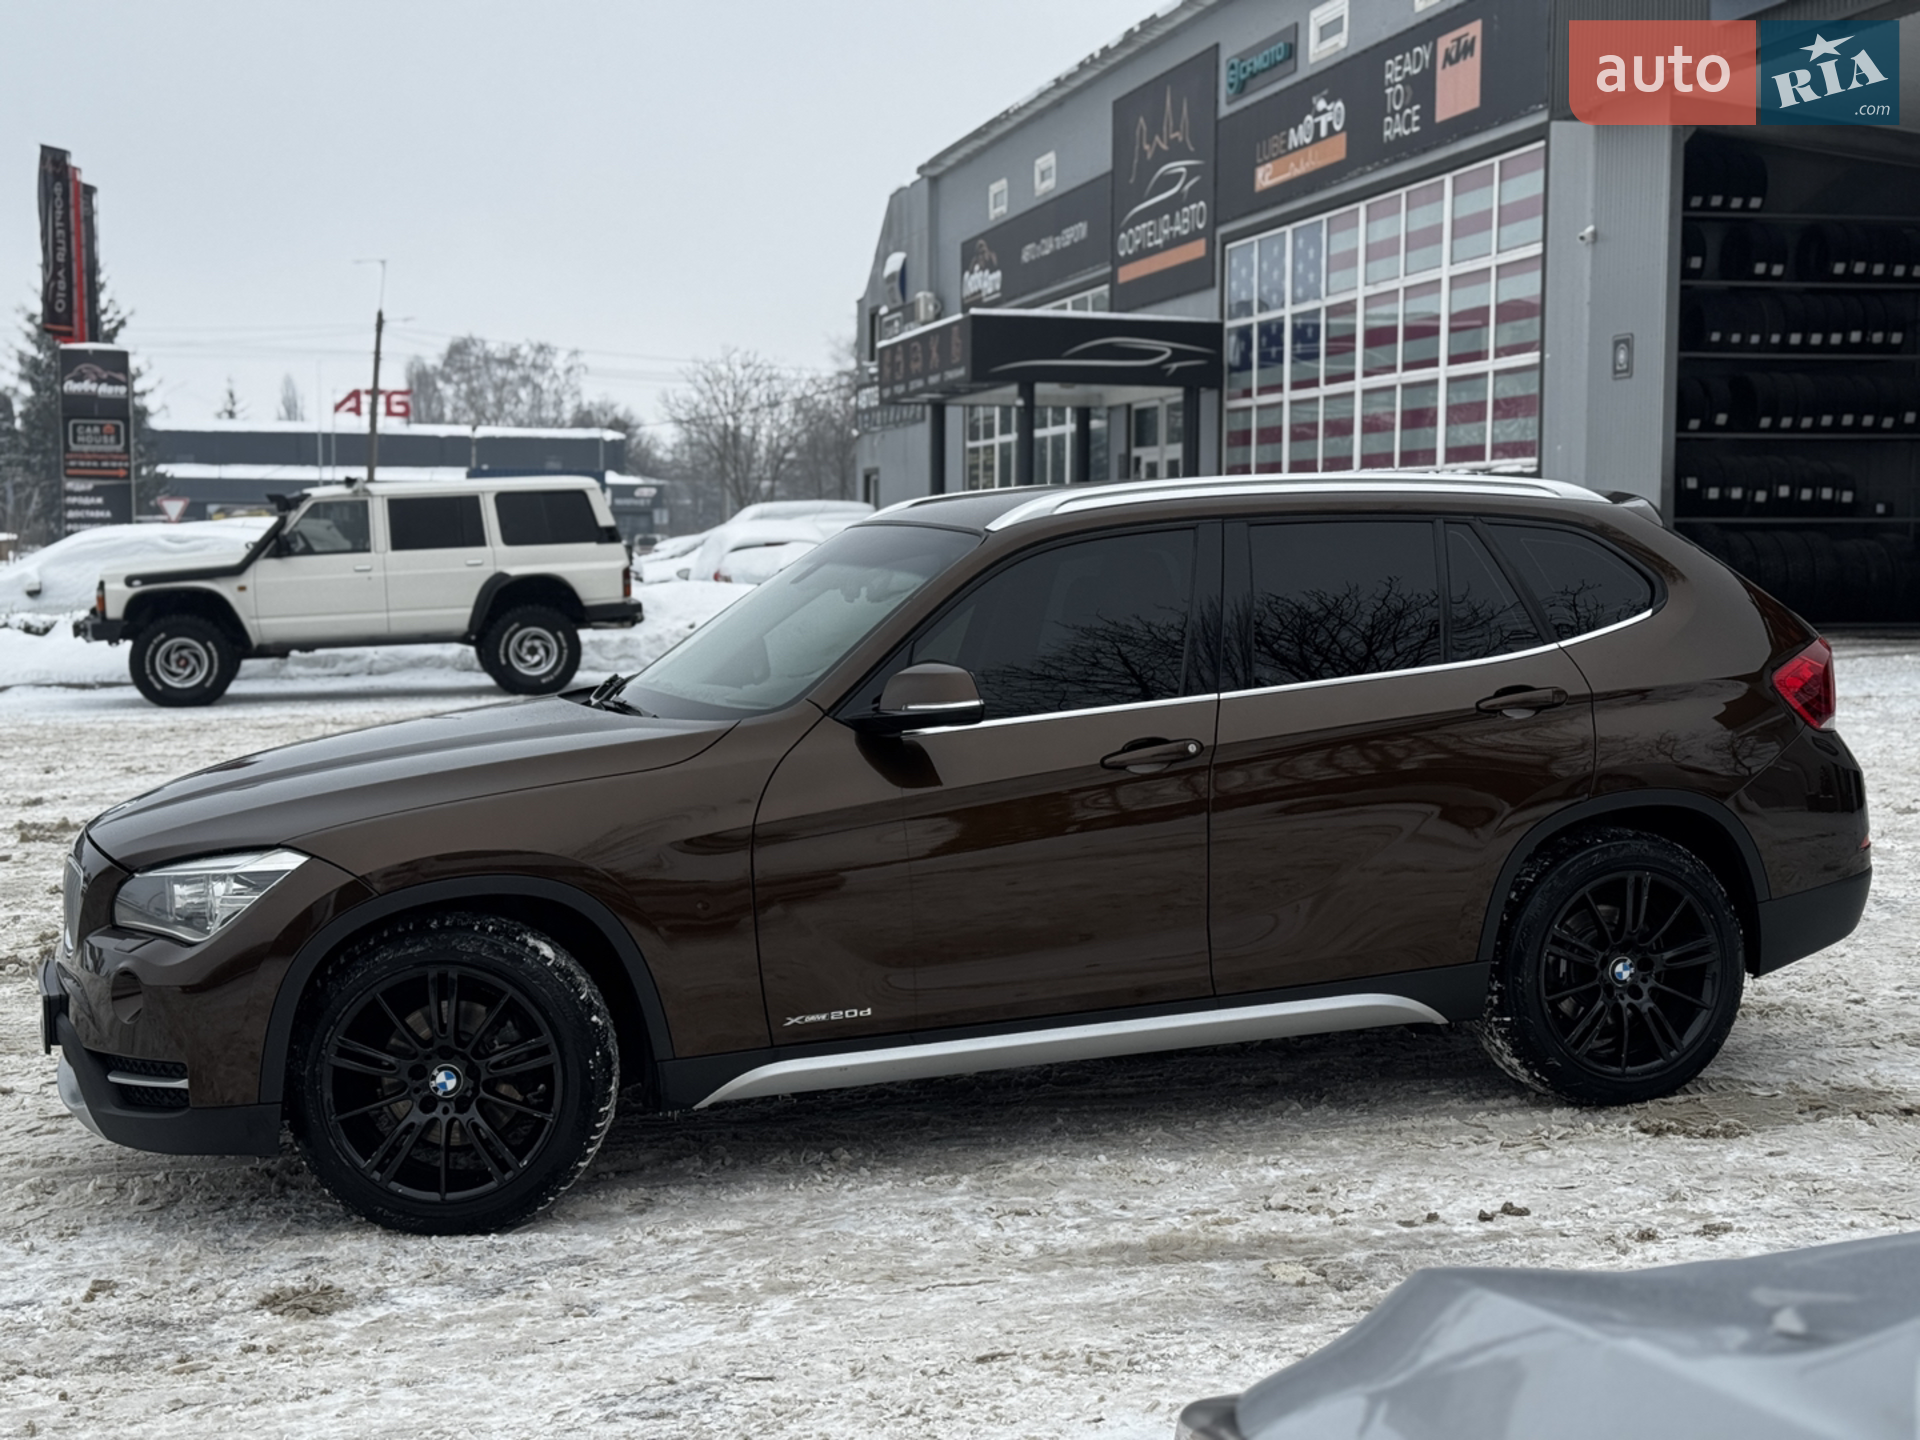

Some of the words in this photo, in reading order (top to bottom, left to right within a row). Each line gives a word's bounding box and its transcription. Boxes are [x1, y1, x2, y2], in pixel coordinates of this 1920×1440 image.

[1240, 41, 1286, 80] CFMOTO
[1384, 41, 1433, 86] READY
[1441, 32, 1477, 70] KTM
[1384, 83, 1405, 114] TO
[1383, 104, 1421, 143] RACE
[1117, 200, 1208, 257] ФОРТЕЦЯ-АВТО
[77, 425, 100, 435] CAR
[77, 435, 116, 444] HOUSE
